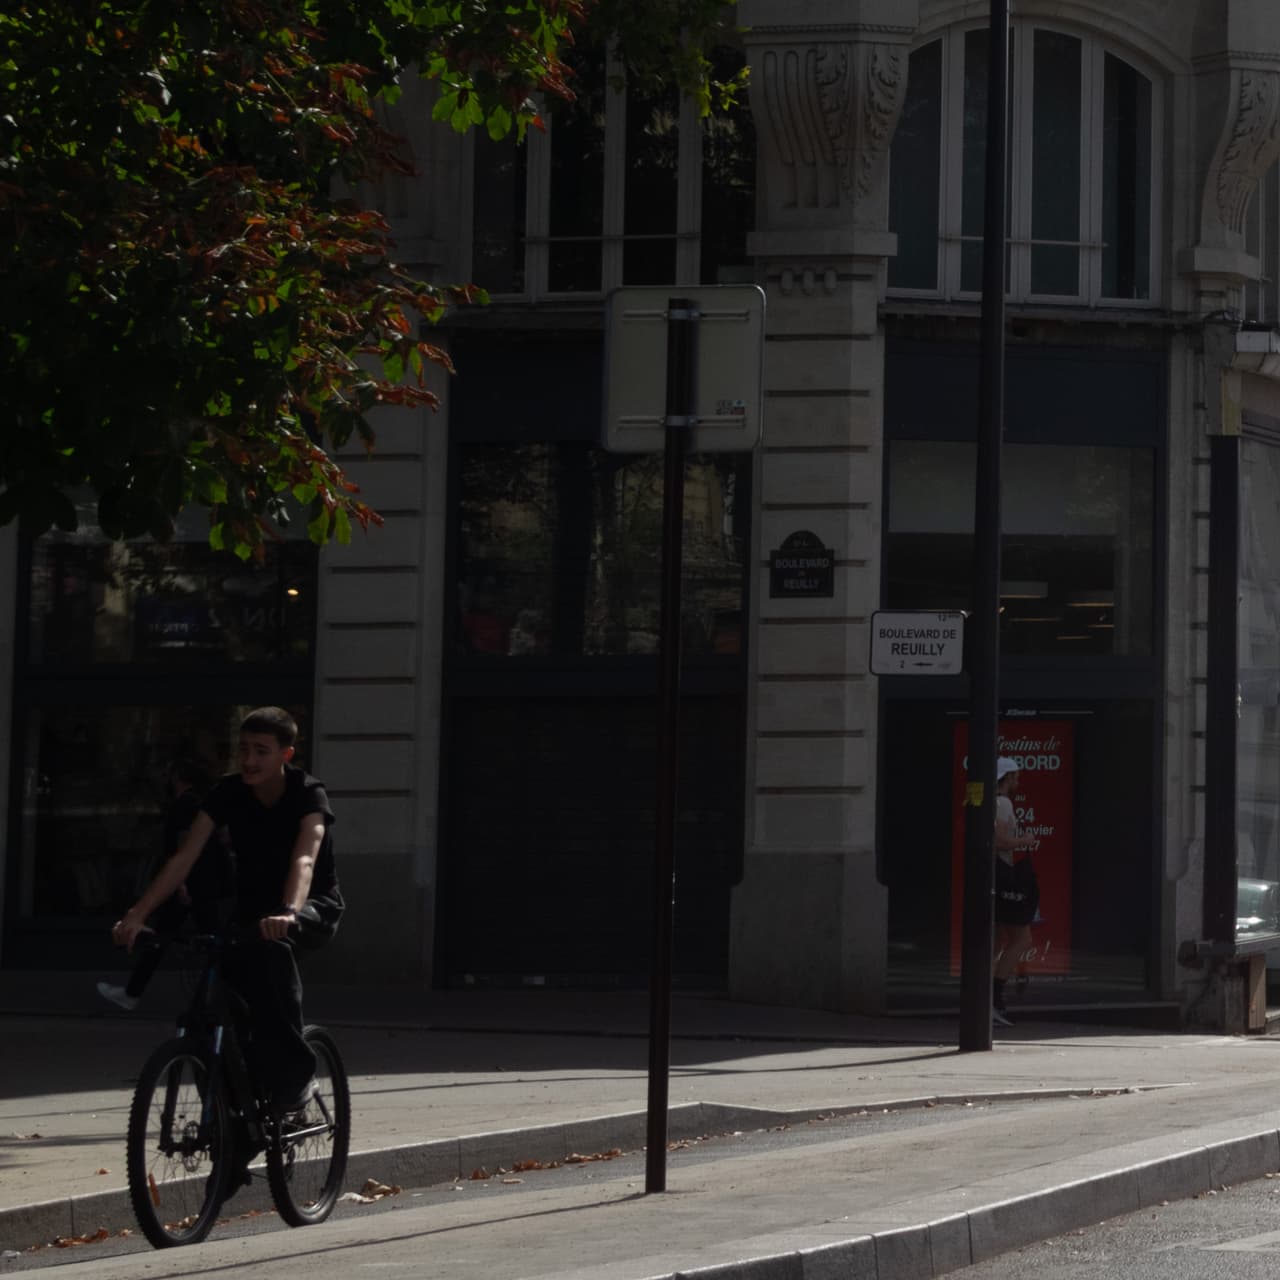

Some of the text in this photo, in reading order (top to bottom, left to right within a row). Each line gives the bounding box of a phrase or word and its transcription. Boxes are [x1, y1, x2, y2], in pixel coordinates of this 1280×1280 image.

[775, 558, 830, 569] BOULEVARD
[783, 578, 820, 589] REUILLY
[879, 628, 956, 639] BOULEVARD DE
[891, 643, 945, 656] REUILLY
